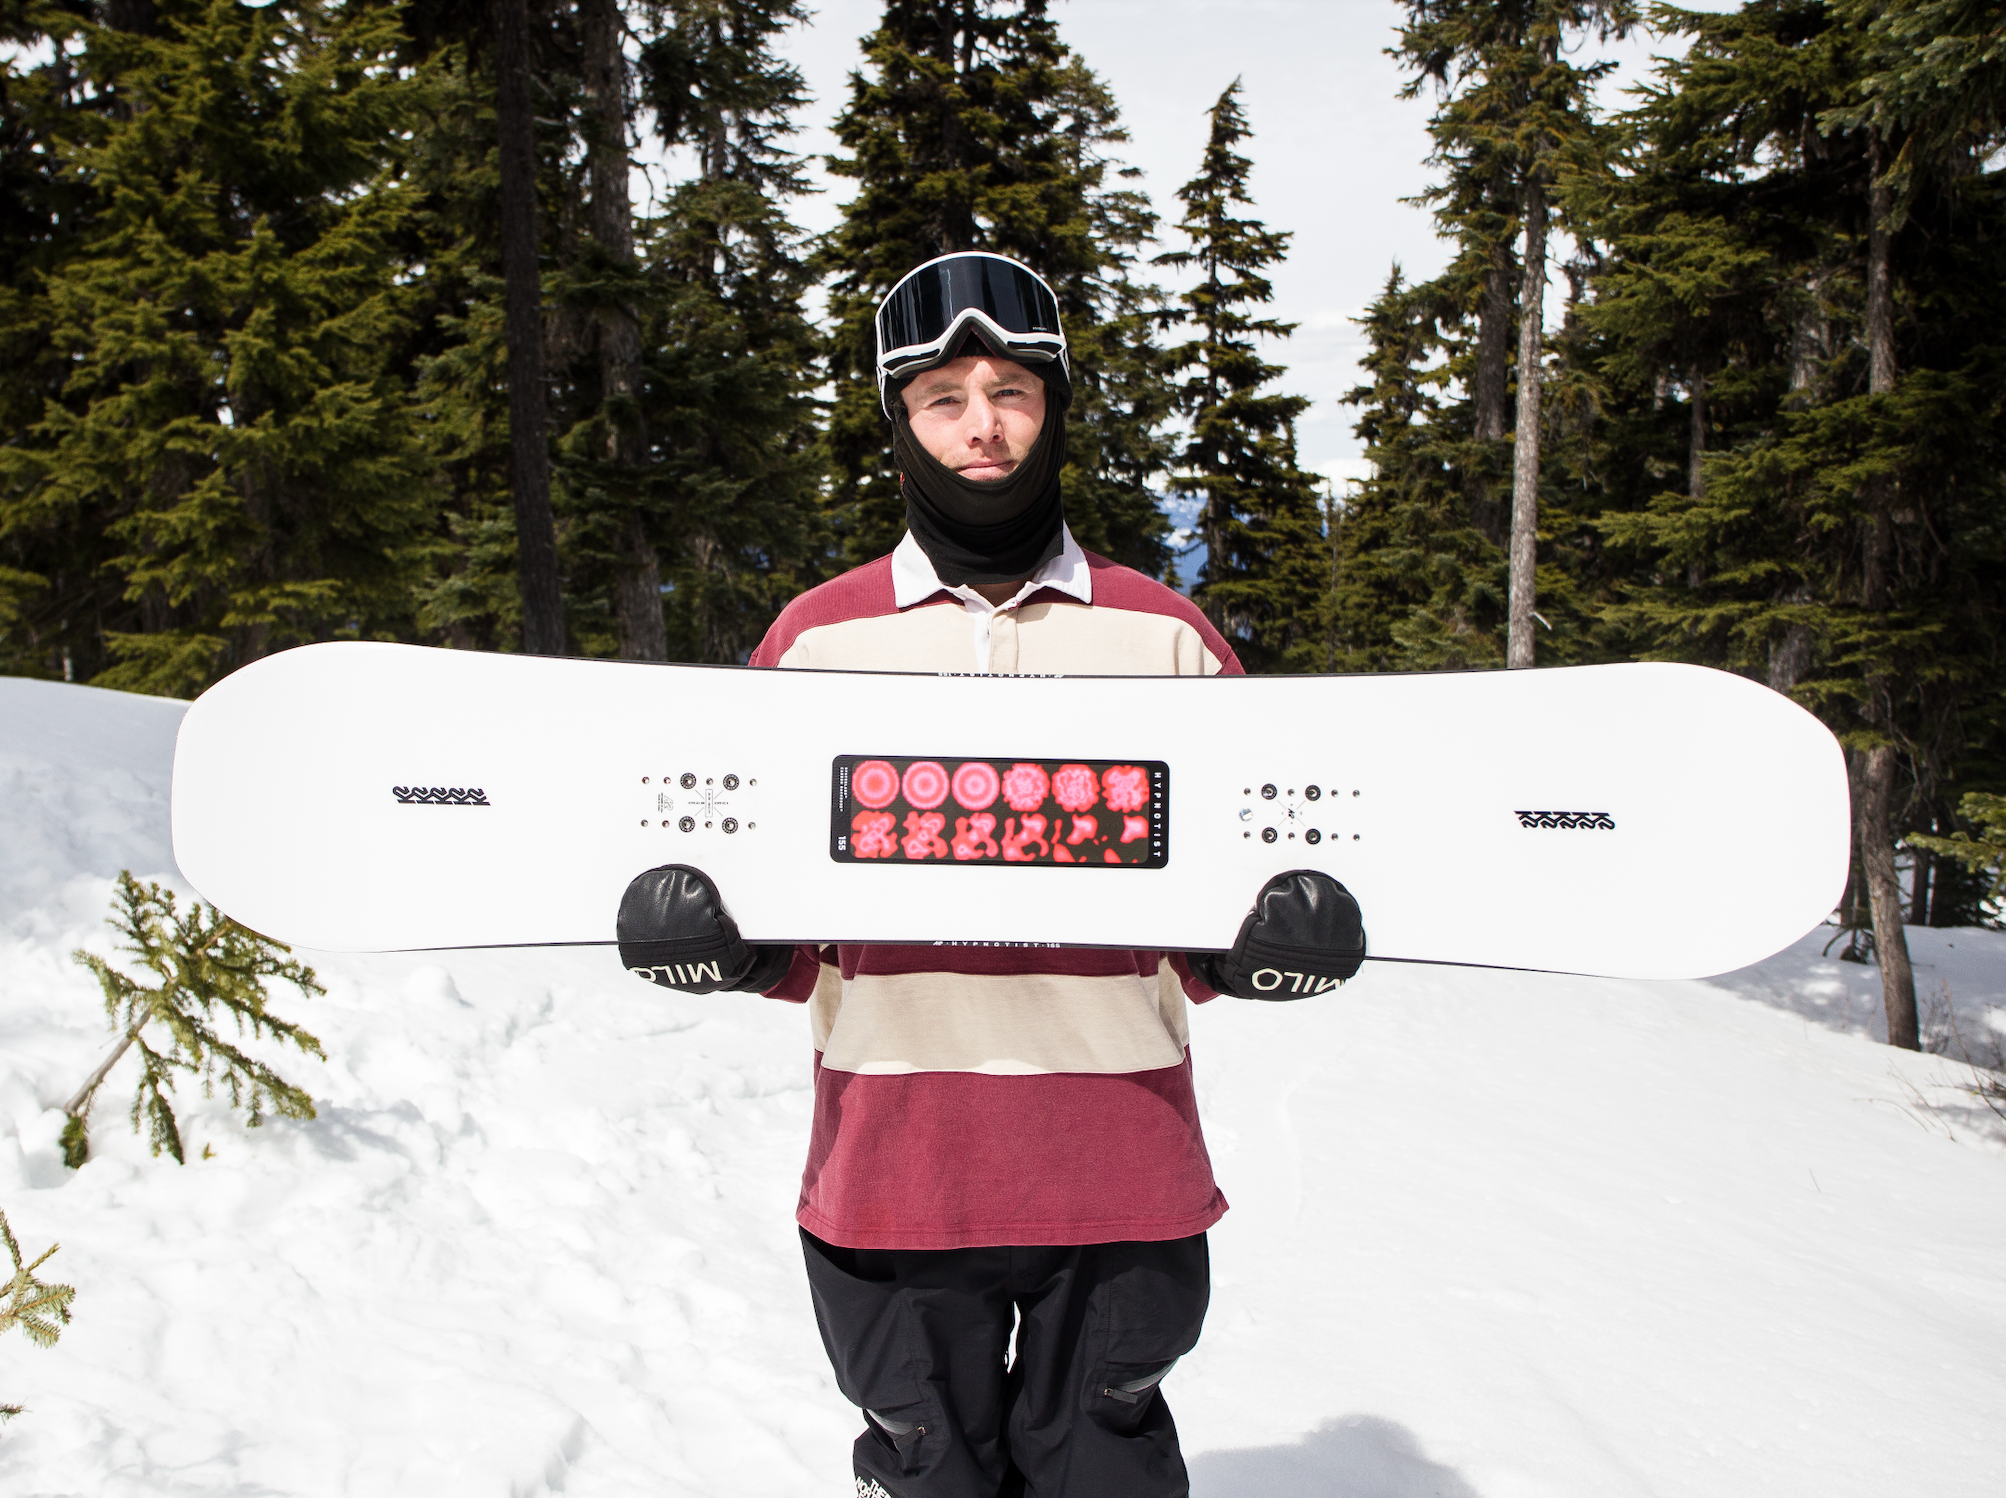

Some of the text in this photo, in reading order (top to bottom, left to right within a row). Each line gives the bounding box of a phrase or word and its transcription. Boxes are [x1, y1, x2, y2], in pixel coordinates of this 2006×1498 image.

[1153, 771, 1162, 858] HYPNOTIST
[838, 836, 847, 851] 155
[629, 961, 723, 984] MILO
[1251, 968, 1346, 993] MILO
